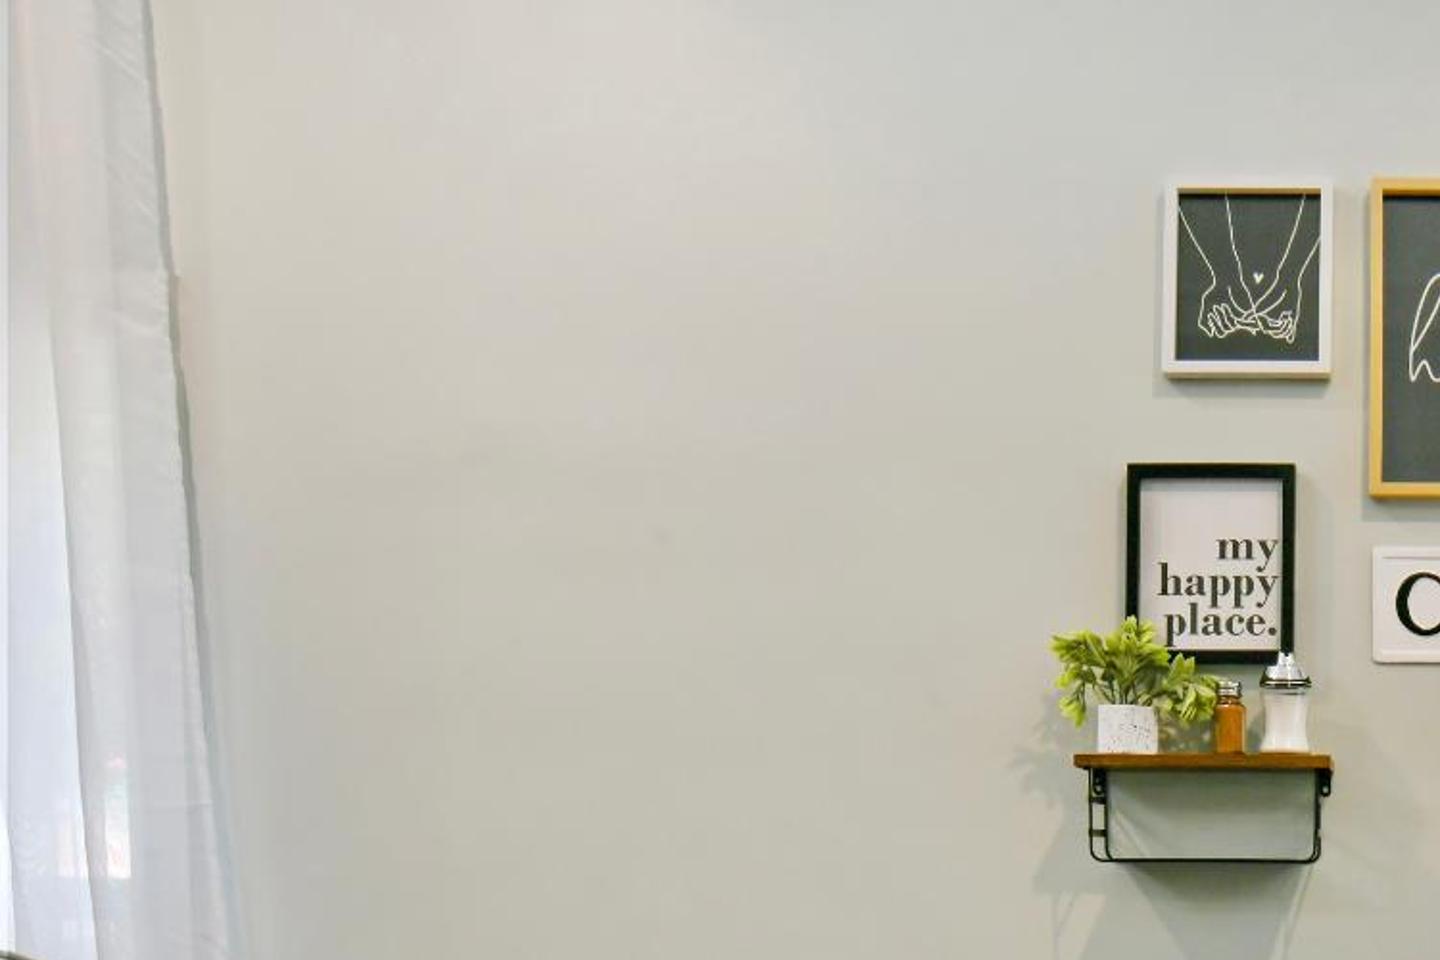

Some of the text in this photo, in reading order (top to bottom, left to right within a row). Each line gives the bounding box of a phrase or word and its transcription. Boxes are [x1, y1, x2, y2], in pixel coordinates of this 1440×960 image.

[1216, 537, 1279, 573] my
[1157, 561, 1279, 608] happy
[1163, 603, 1278, 648] place.
